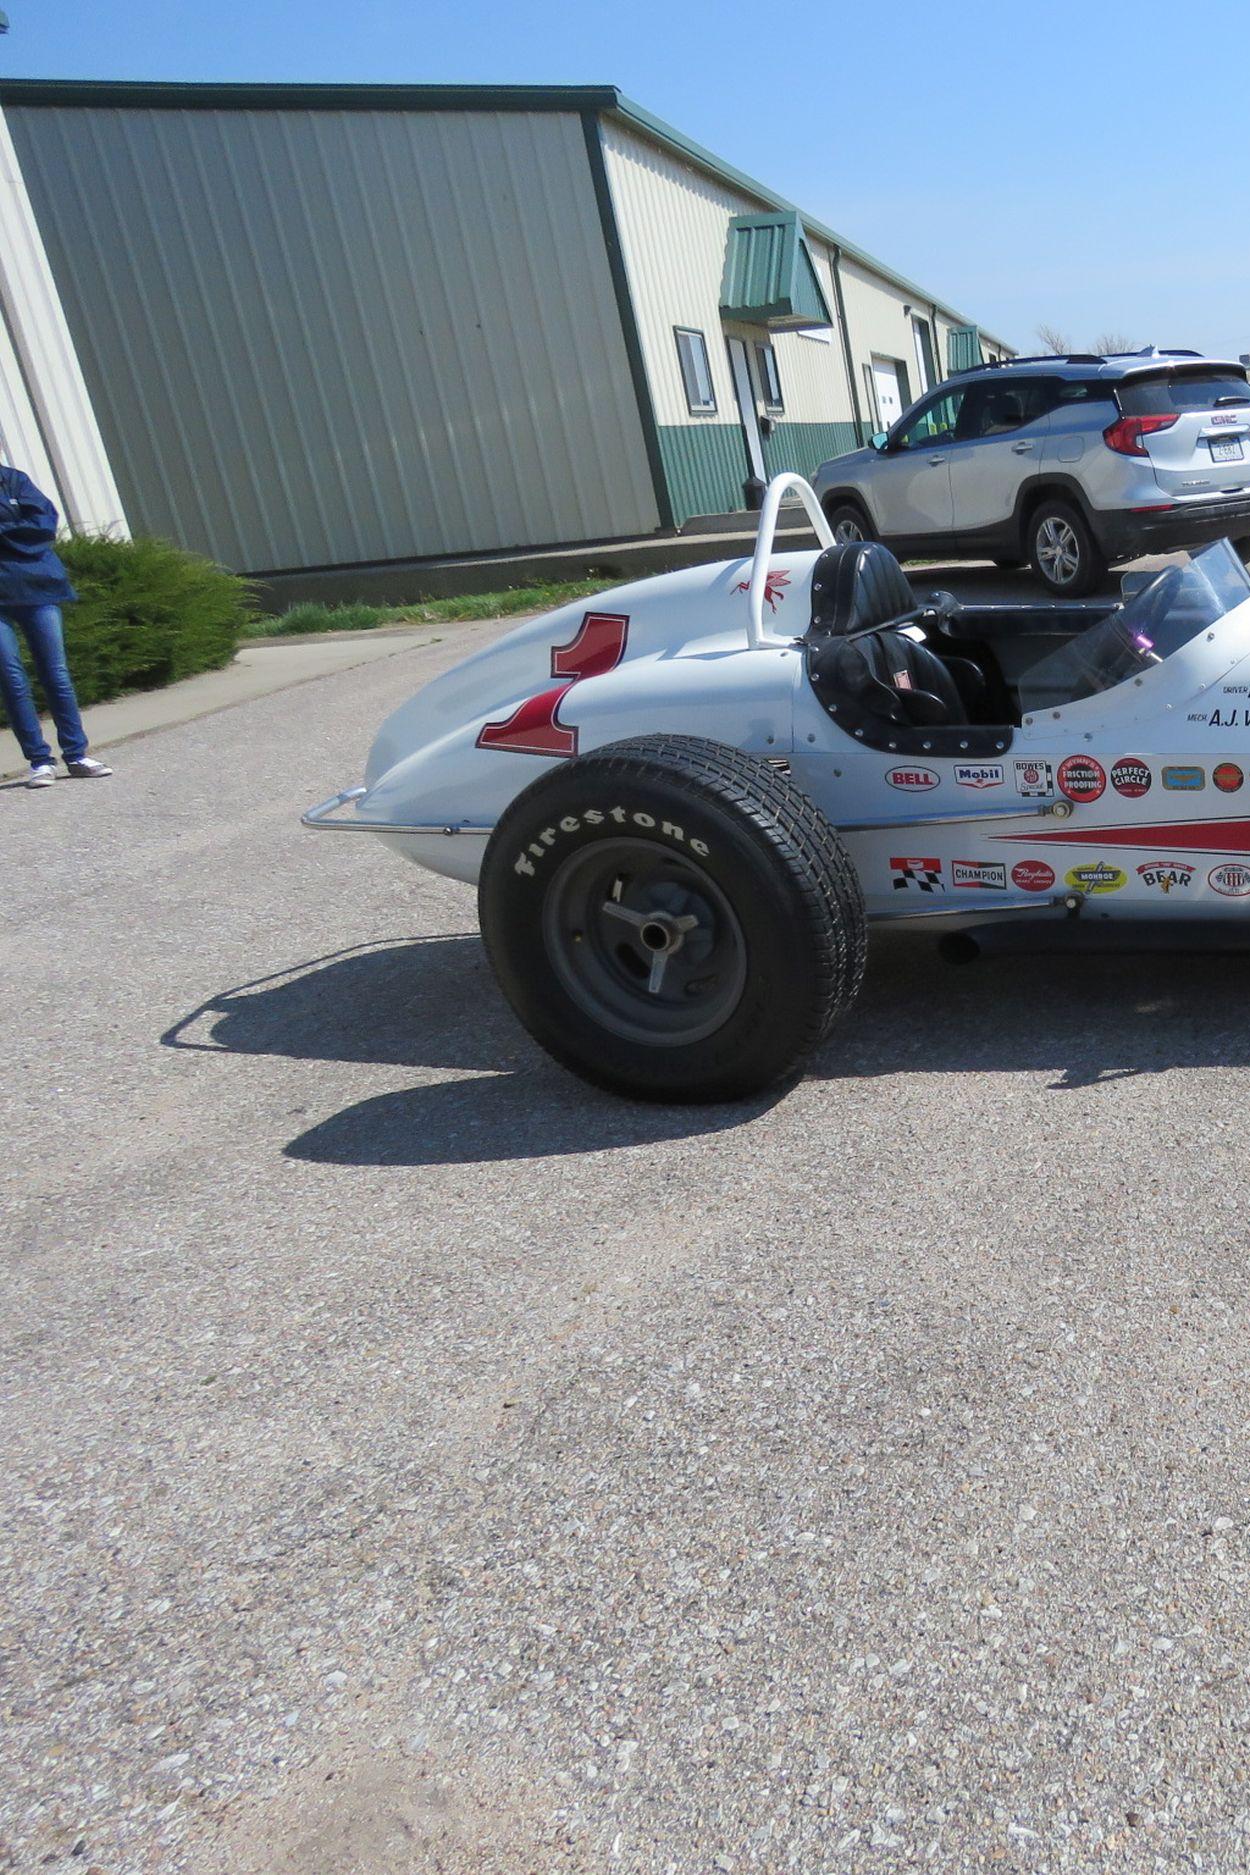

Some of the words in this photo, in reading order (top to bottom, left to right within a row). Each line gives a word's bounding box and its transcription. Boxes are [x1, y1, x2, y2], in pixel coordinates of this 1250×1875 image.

[1223, 685, 1248, 694] DRIVER
[1208, 709, 1239, 727] A.J.
[1016, 762, 1045, 770] BOWES
[892, 772, 934, 785] BELL
[959, 769, 999, 779] Mobil
[1062, 770, 1100, 778] FRICTION
[1111, 767, 1150, 779] PERFECT
[1064, 780, 1102, 789] PROOFING
[1114, 775, 1147, 786] CIRCLE
[514, 806, 710, 876] Firestone
[955, 869, 1003, 880] CHAMPION
[1142, 870, 1191, 888] BEAR
